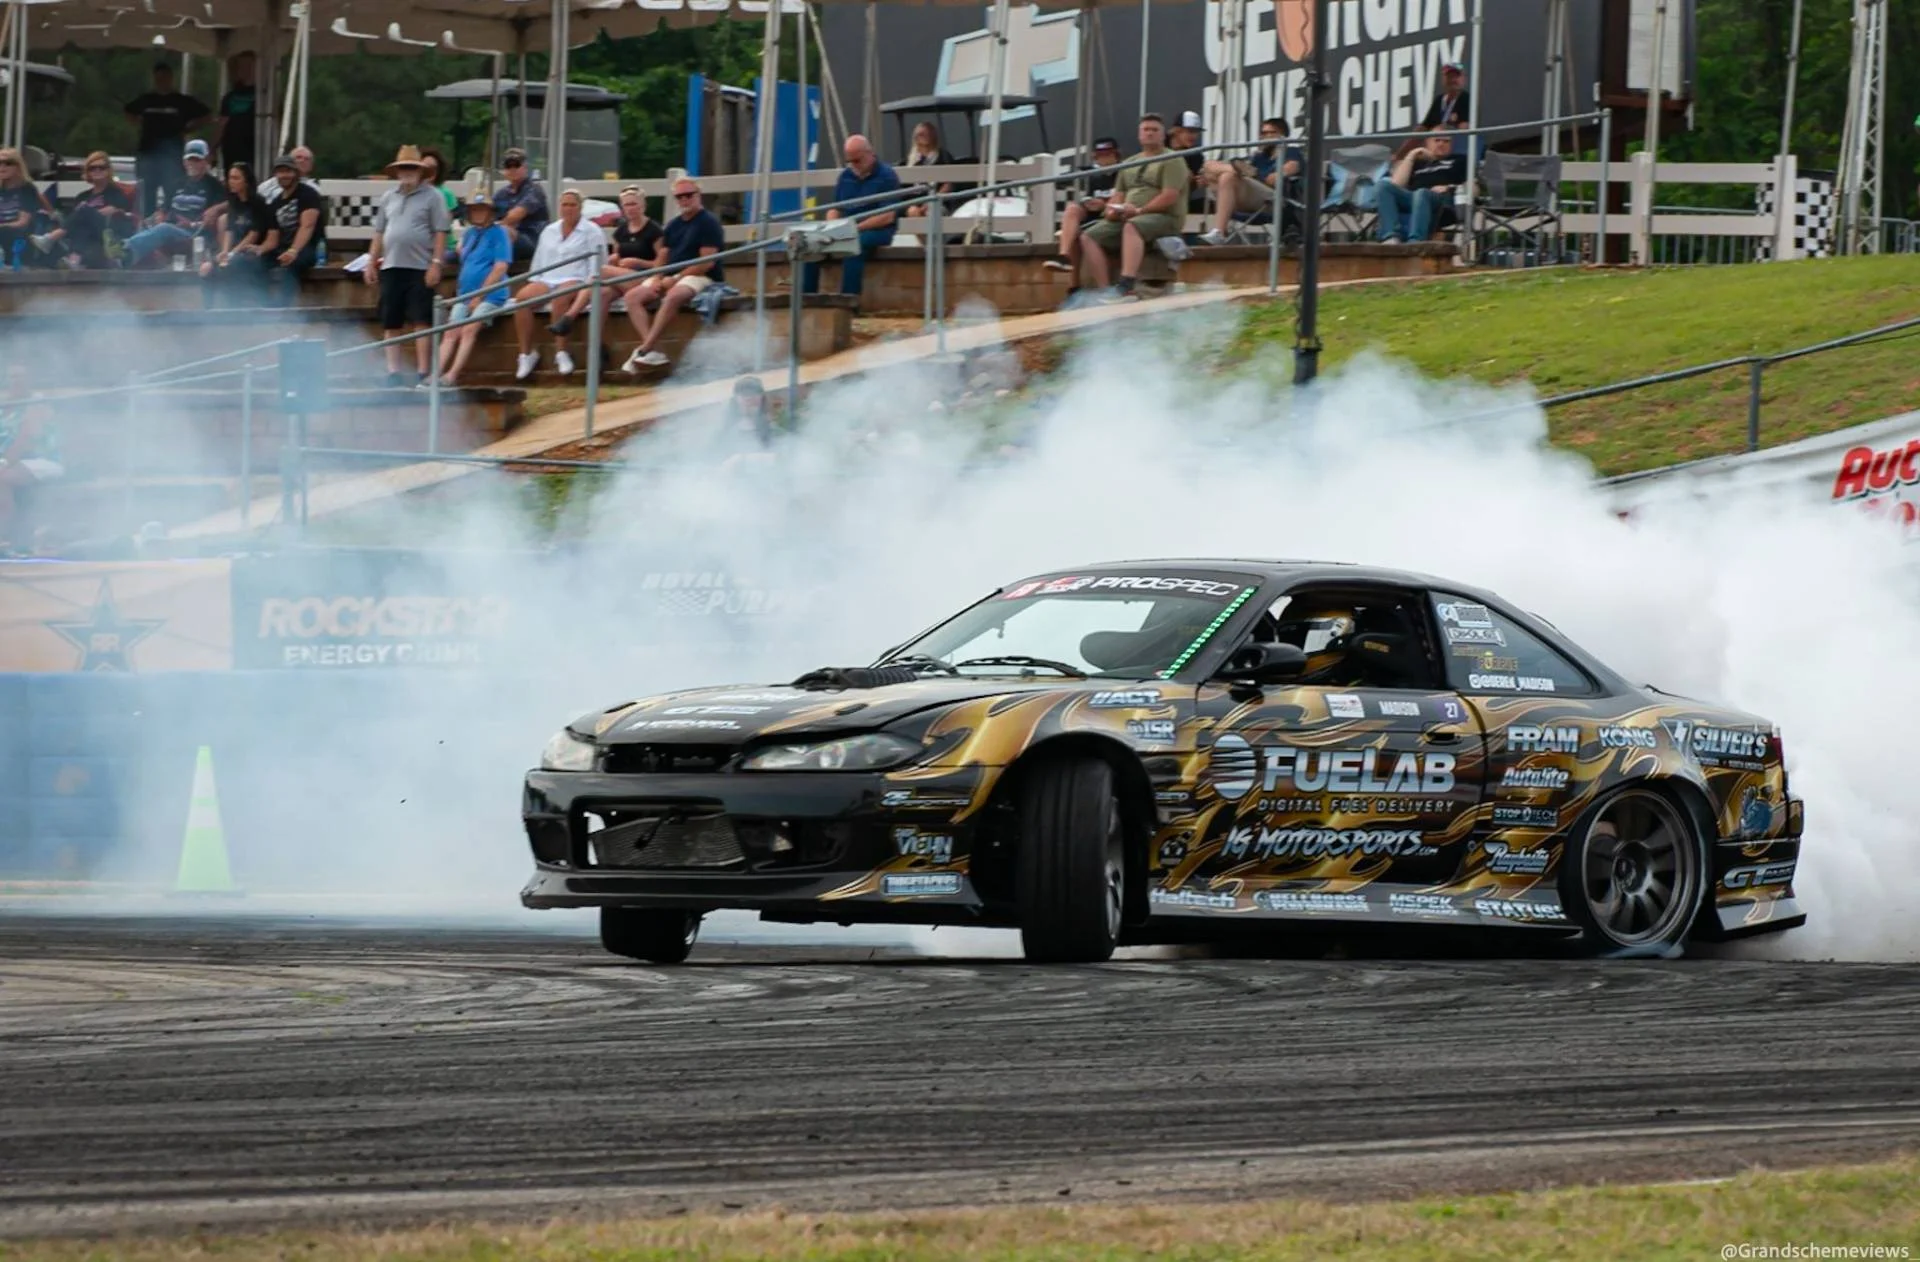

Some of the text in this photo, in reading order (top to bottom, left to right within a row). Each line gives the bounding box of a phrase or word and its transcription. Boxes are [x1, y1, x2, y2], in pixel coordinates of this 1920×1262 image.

[1338, 36, 1466, 137] CHEVY
[1090, 576, 1240, 596] PROSPEC
[257, 596, 510, 639] ROCKSTAR
[284, 643, 392, 665] ENERGY
[1444, 702, 1459, 718] 27
[1507, 726, 1579, 753] FRAM
[1261, 746, 1457, 793] FUELAB
[1501, 767, 1570, 788] Autolite
[1257, 799, 1455, 813] DIGITAL FUEL DELIVERY
[1494, 807, 1521, 819] STOP
